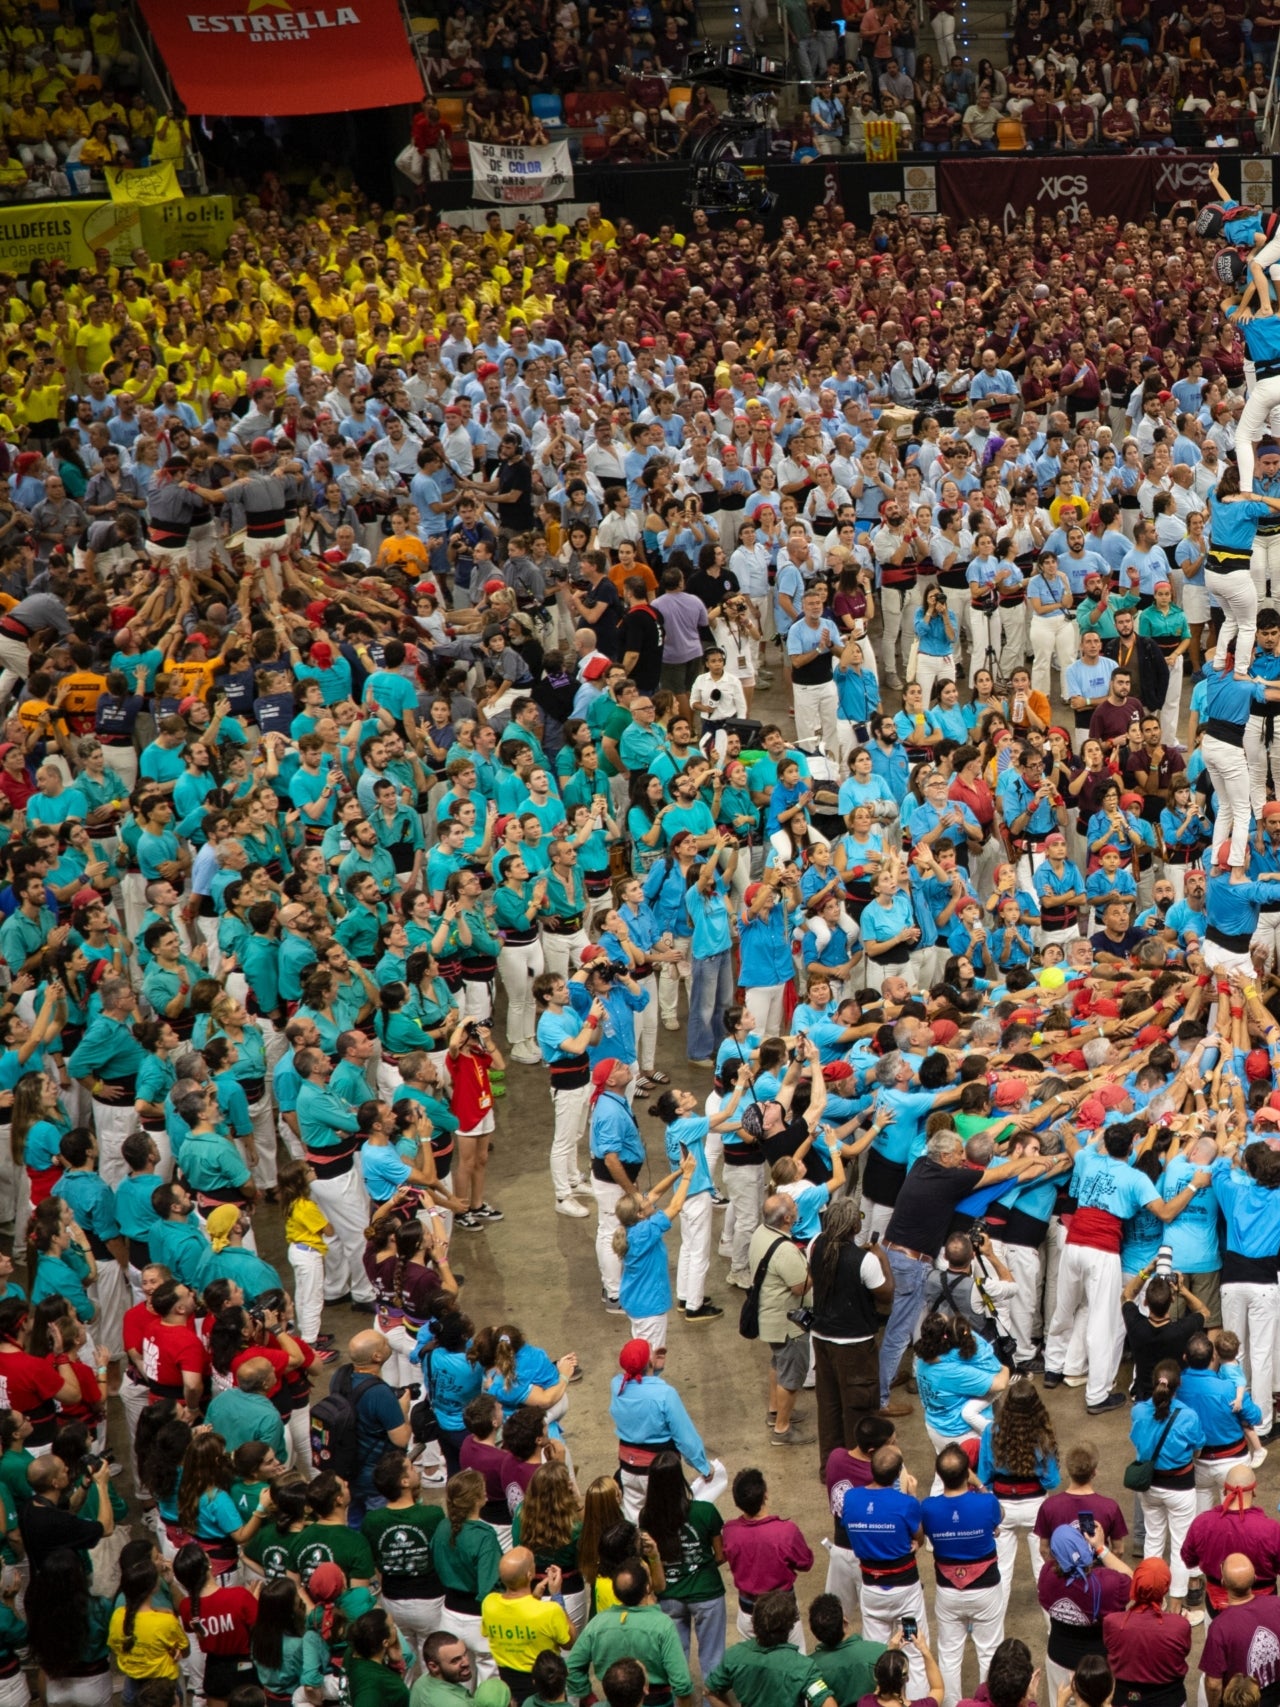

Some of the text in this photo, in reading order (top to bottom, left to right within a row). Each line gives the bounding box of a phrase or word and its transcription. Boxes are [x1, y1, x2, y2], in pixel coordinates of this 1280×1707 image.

[187, 7, 361, 32] ESTRELLA
[249, 30, 310, 42] DAMM
[482, 145, 525, 160] 50 ANYS
[490, 159, 502, 172] DE
[509, 160, 542, 174] COLOR
[487, 174, 525, 185] 50 ANYS
[1037, 175, 1088, 200] XICS
[957, 1528, 984, 1537] associats
[200, 1613, 235, 1637] SOM
